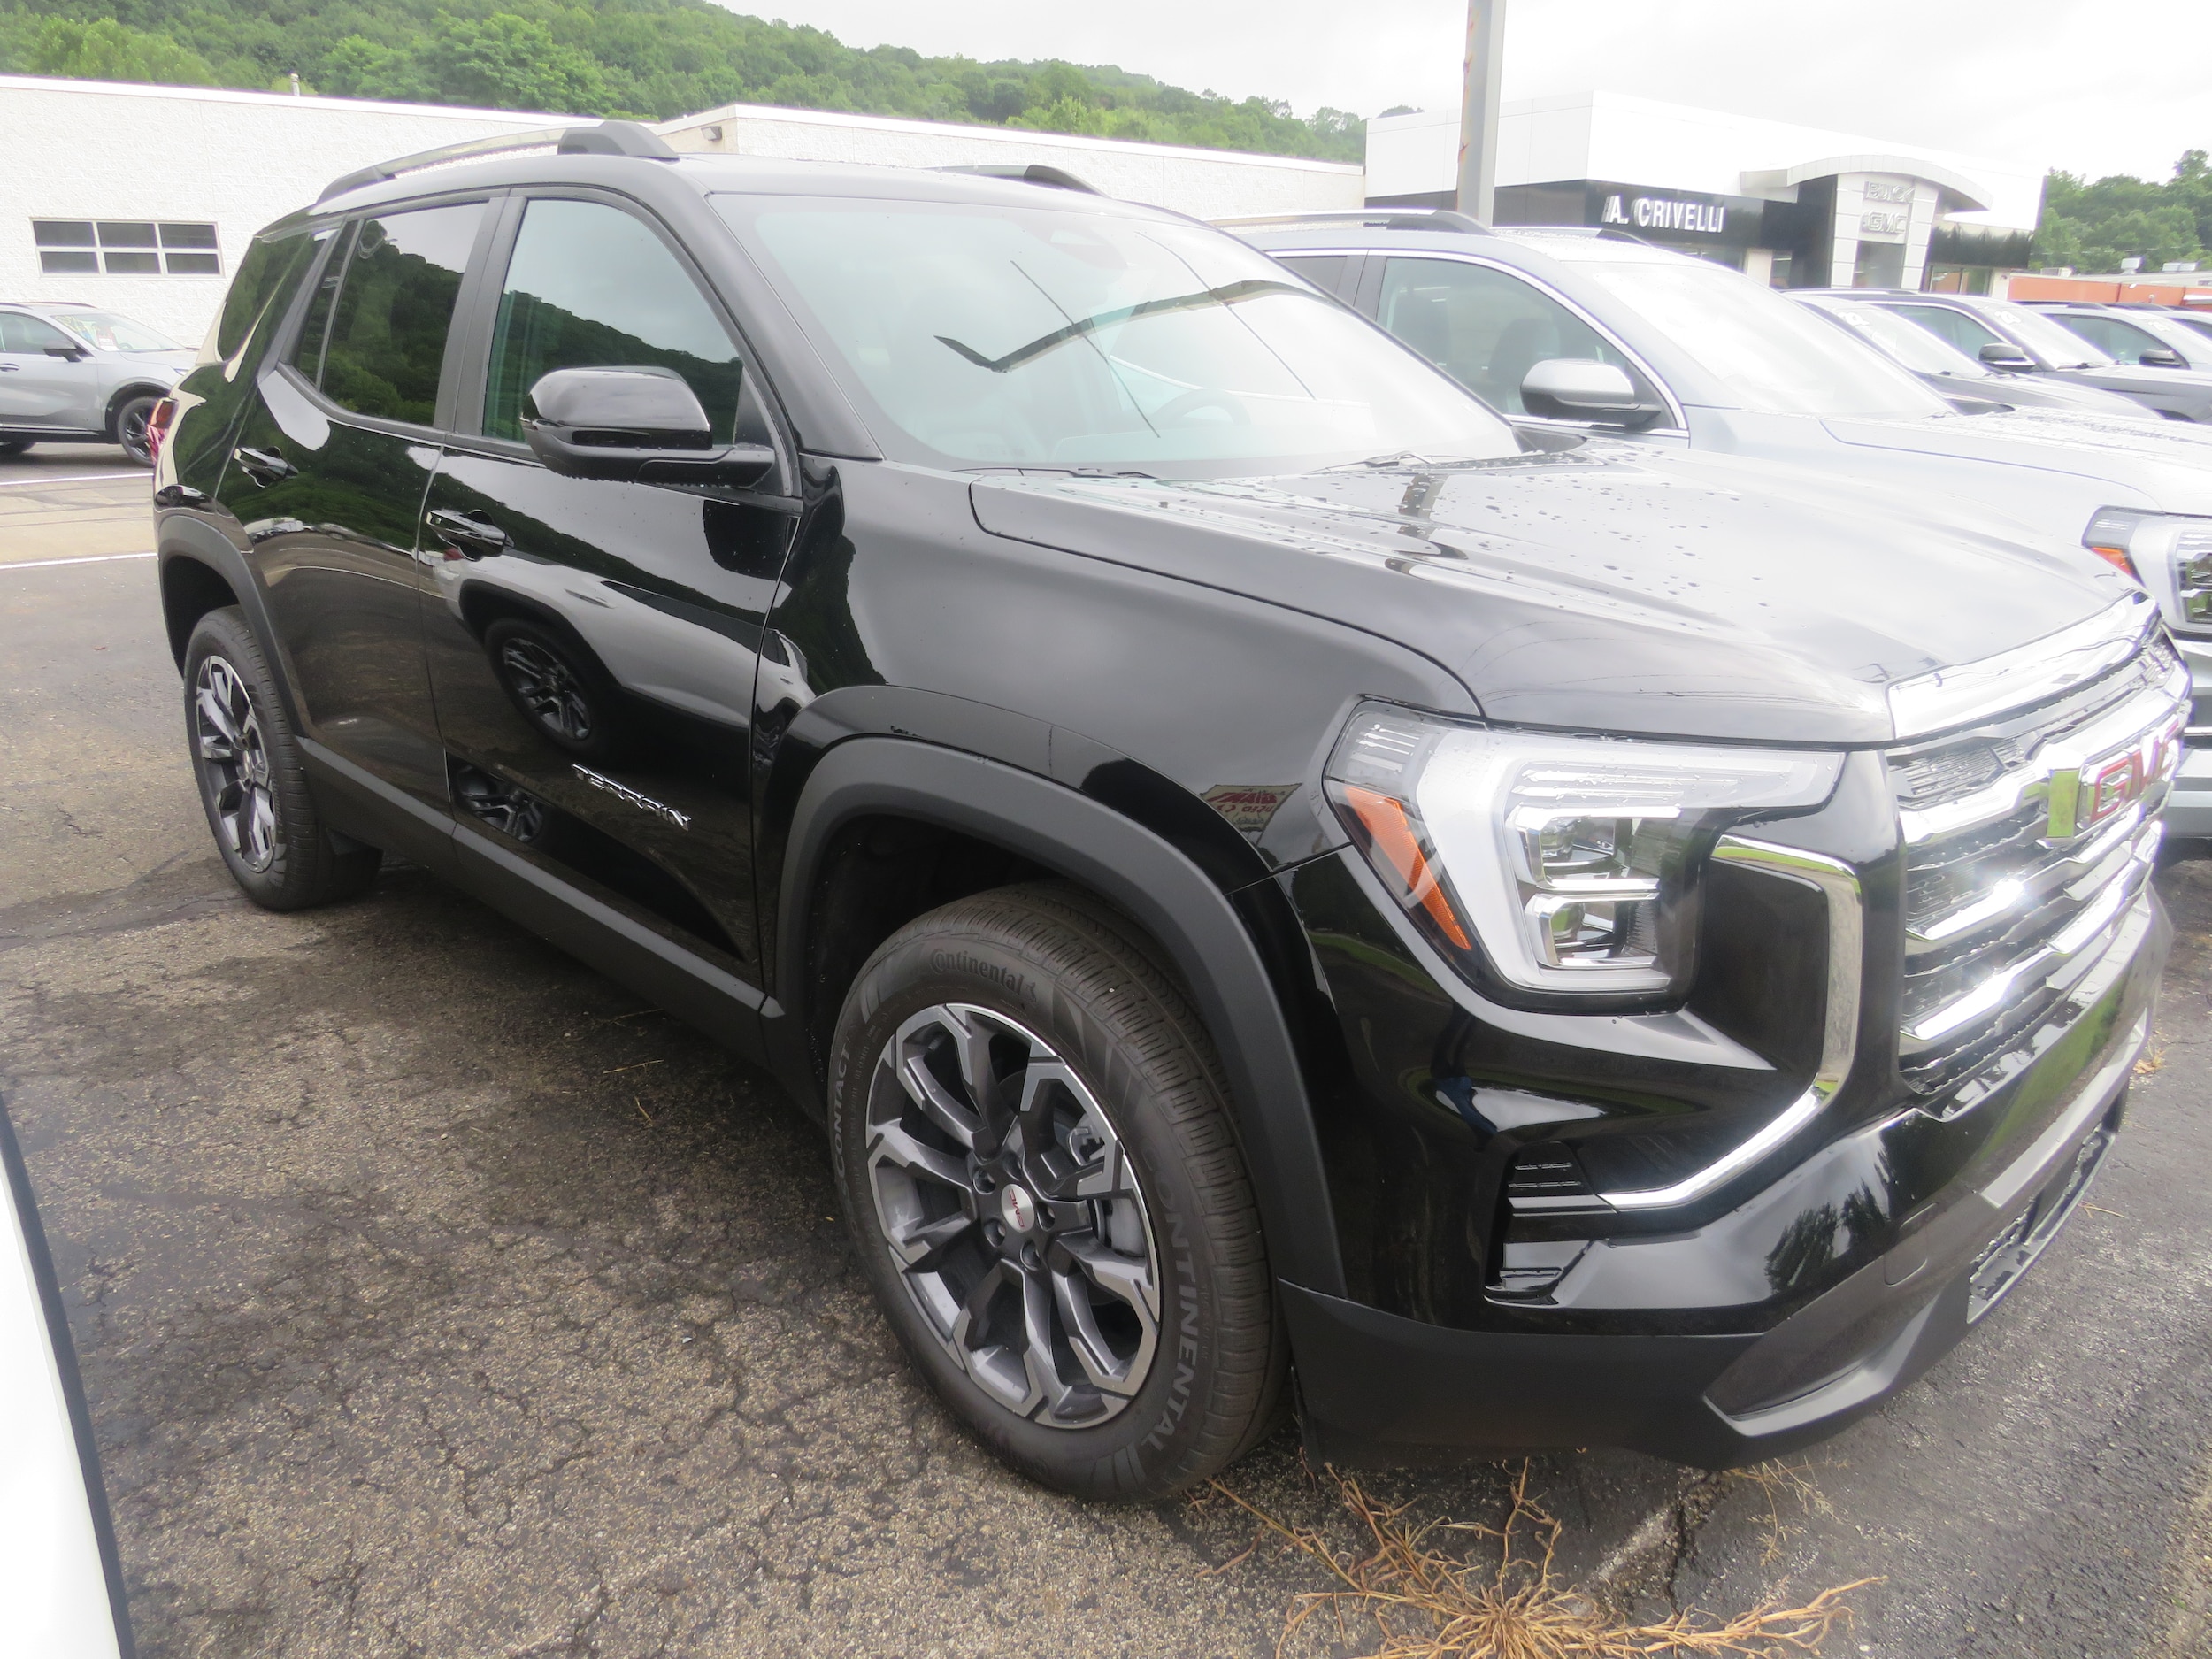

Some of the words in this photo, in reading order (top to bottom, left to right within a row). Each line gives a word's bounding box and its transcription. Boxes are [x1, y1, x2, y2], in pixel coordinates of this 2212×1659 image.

[1602, 196, 1629, 225] A.
[1632, 197, 1724, 233] CRIVELLI
[1861, 211, 1908, 234] GMC
[572, 763, 692, 832] TERRAIN
[929, 948, 1025, 995] Continental
[1008, 1188, 1025, 1228] GMC
